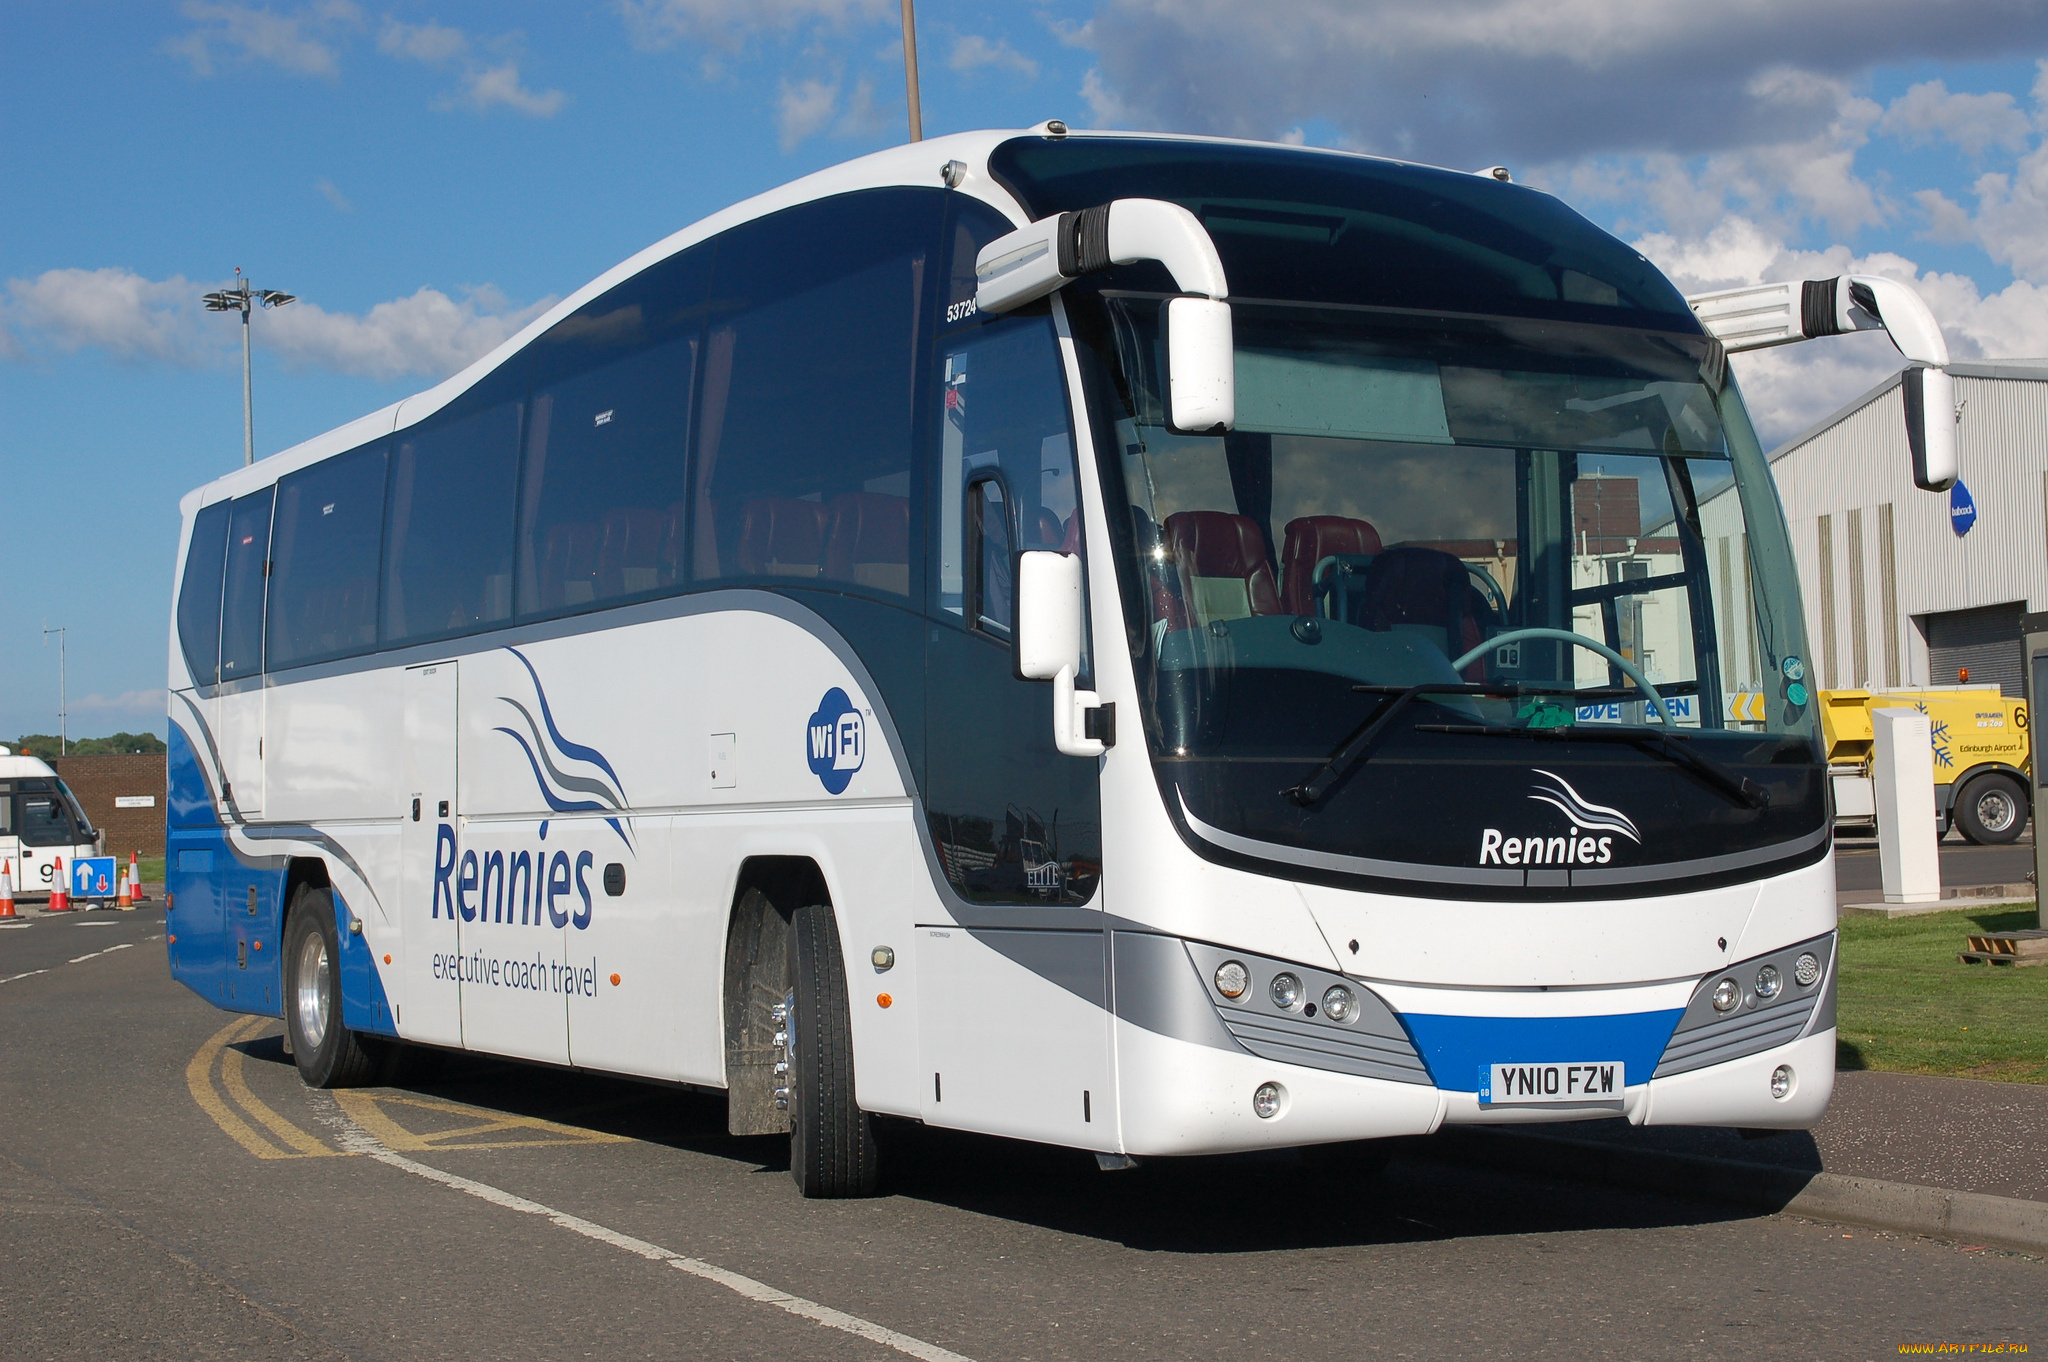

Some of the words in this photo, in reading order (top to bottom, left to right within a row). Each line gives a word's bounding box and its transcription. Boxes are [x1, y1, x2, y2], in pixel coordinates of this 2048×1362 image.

[946, 297, 977, 323] 53724
[2014, 706, 2028, 728] 6
[1959, 744, 1993, 753] Edinburgh
[1994, 744, 2017, 752] Airport
[1479, 826, 1612, 865] Rennies
[40, 863, 54, 883] 9
[432, 820, 594, 931] Rennies
[1027, 864, 1059, 886] ELITE
[433, 948, 500, 987] executive
[503, 951, 547, 991] coach
[551, 956, 598, 998] travel
[1480, 1088, 1490, 1097] GB
[1501, 1066, 1559, 1096] YN10
[1567, 1065, 1615, 1094] FZW
